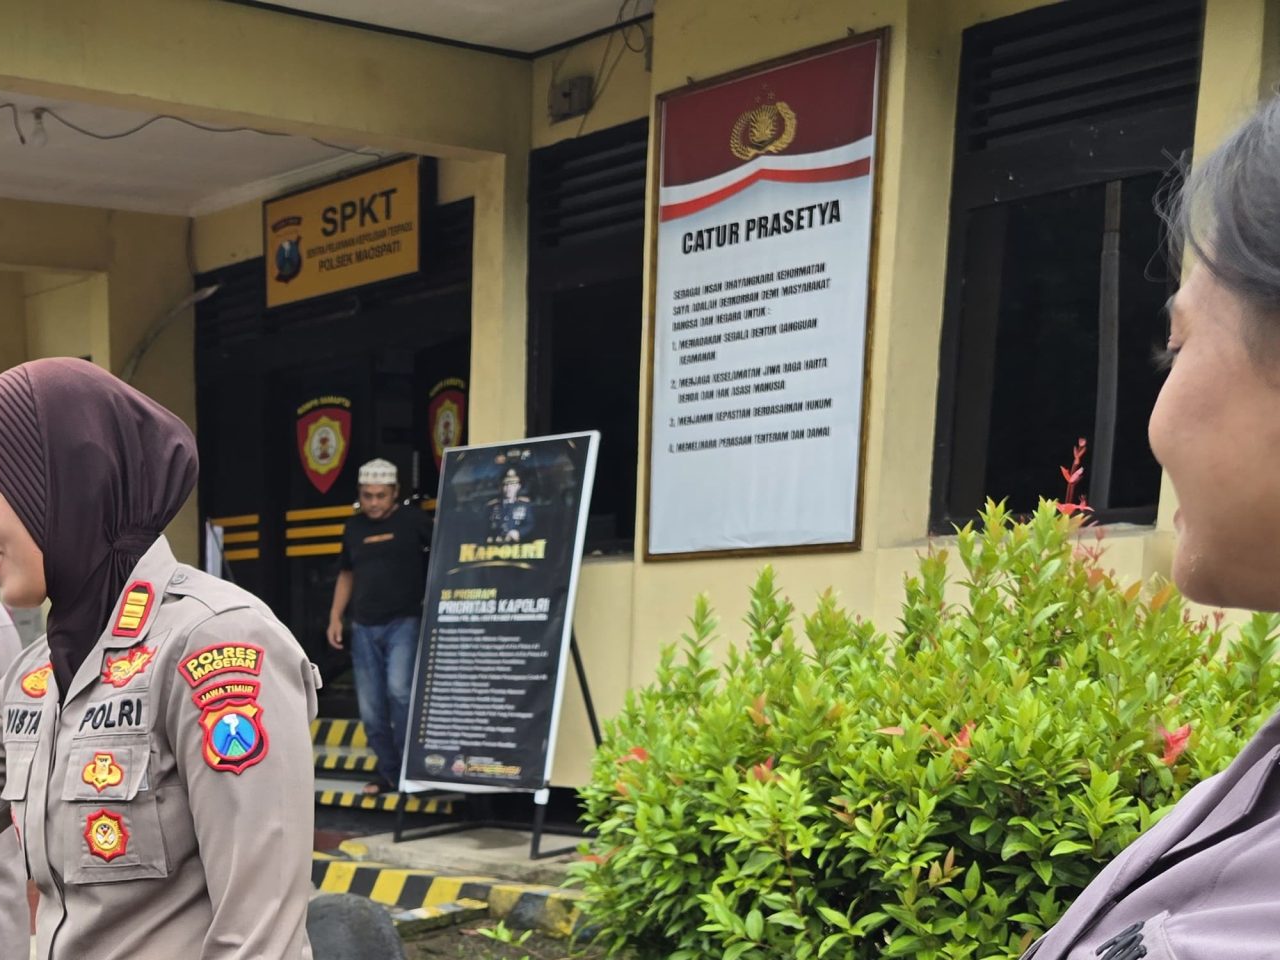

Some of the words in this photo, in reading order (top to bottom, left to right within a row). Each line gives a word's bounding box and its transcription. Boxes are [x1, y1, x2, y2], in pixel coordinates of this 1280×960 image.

[321, 188, 397, 237] SPKT
[682, 222, 740, 255] CATUR
[745, 199, 842, 242] PRASETYA
[319, 253, 353, 272] POLSEK
[355, 240, 401, 262] MAOSPATI
[673, 287, 701, 300] SEBAGAI
[702, 282, 722, 295] INSAN
[777, 262, 826, 282] KEHORMATAN
[673, 305, 690, 316] SAYA
[691, 299, 718, 313] ADALAH
[720, 291, 759, 308] BERKORBAN
[761, 287, 779, 299] DEMI
[782, 278, 831, 297] MASYARAKAT
[672, 319, 698, 332] BANGSA
[700, 316, 714, 327] DAN
[716, 311, 742, 324] NEGARA
[744, 307, 766, 320] UNTUK
[723, 329, 749, 343] SEGALA
[751, 325, 777, 339] BENTUK
[779, 318, 818, 333] GANGGUAN
[679, 375, 711, 388] MENJAGA
[712, 367, 761, 384] KESELAMATAN
[700, 390, 714, 401] DAN
[716, 388, 730, 399] HAK
[731, 385, 751, 396] ASASI
[753, 380, 785, 394] MANUSIA
[677, 414, 713, 426] MENJAMIN
[715, 408, 751, 422] KEPASTIAN
[753, 402, 803, 418] BERDASARKAN
[805, 398, 832, 410] HUKUM
[719, 434, 752, 447] PERASAAN
[790, 428, 805, 440] DAN
[806, 426, 830, 438] DAMAI
[438, 600, 497, 614] PRIORITAS
[497, 598, 550, 613] KAPOLRI
[186, 647, 257, 672] POLRES
[191, 658, 255, 680] MAGETAN
[201, 688, 223, 701] JAWA
[225, 685, 253, 695] TIMUR
[78, 698, 143, 732] POLRI
